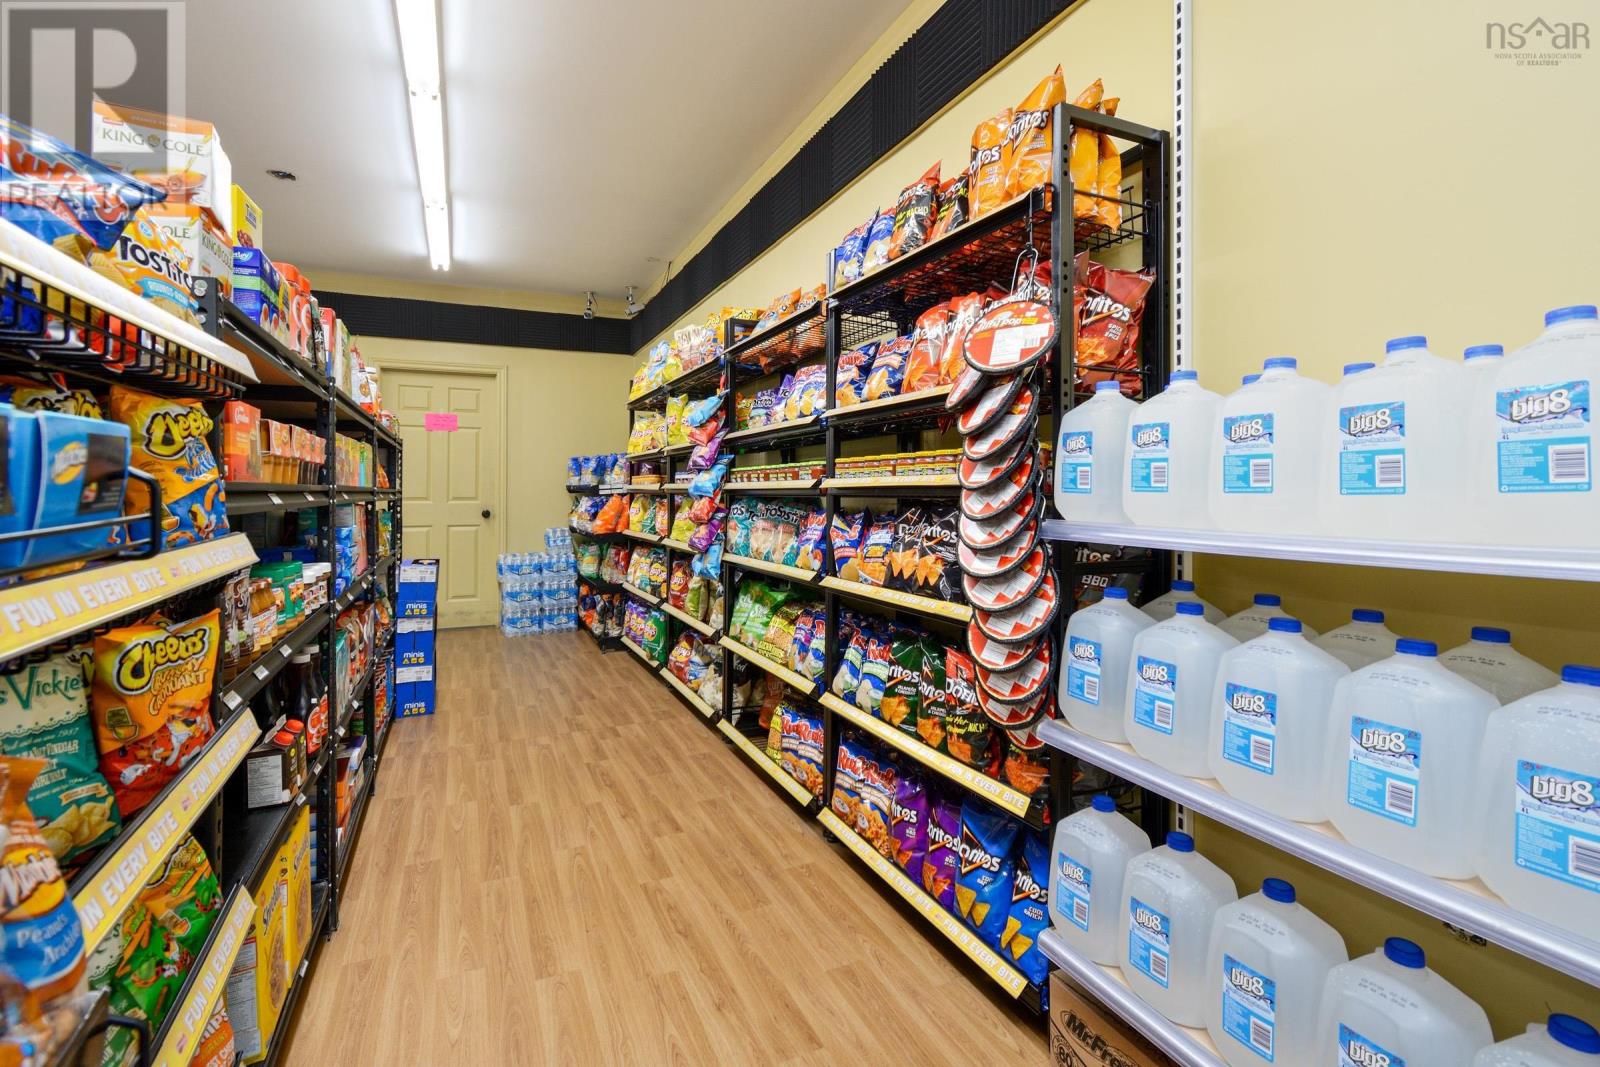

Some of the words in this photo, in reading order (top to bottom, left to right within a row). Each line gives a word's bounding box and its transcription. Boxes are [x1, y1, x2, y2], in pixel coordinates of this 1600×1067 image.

[103, 128, 145, 146] KING
[162, 138, 207, 157] COLE
[163, 225, 190, 239] OLE
[1511, 388, 1571, 421] big8
[1230, 419, 1264, 442] big8
[1349, 407, 1392, 435] big8
[1066, 435, 1086, 452] big8
[1137, 427, 1161, 446] big8
[3, 595, 57, 634] FUN
[56, 590, 82, 618] IN
[78, 574, 133, 609] EVERY
[133, 566, 167, 594] BITE
[117, 627, 208, 695] Cheetos
[1074, 643, 1095, 659] big8
[888, 665, 921, 683] ritos
[1142, 664, 1168, 681] big8
[404, 701, 425, 709] minis
[1232, 692, 1265, 713] big8
[1361, 728, 1406, 753] big8
[974, 777, 1002, 795] EVERY
[1002, 788, 1025, 808] BITE
[1531, 775, 1595, 806] big8
[959, 842, 1001, 872] oritos
[80, 898, 105, 932] IN
[102, 842, 149, 906] EVERY
[149, 810, 180, 851] BITE
[1063, 861, 1084, 881] big8
[1028, 906, 1043, 914] COOL
[1136, 908, 1162, 931] big8
[184, 992, 208, 1032] FUN
[202, 973, 217, 995] IN
[212, 922, 237, 974] EVERY
[969, 943, 998, 968] EVERY
[999, 965, 1022, 989] BITE
[1231, 967, 1264, 995] big8
[1066, 1013, 1092, 1046] Mr.
